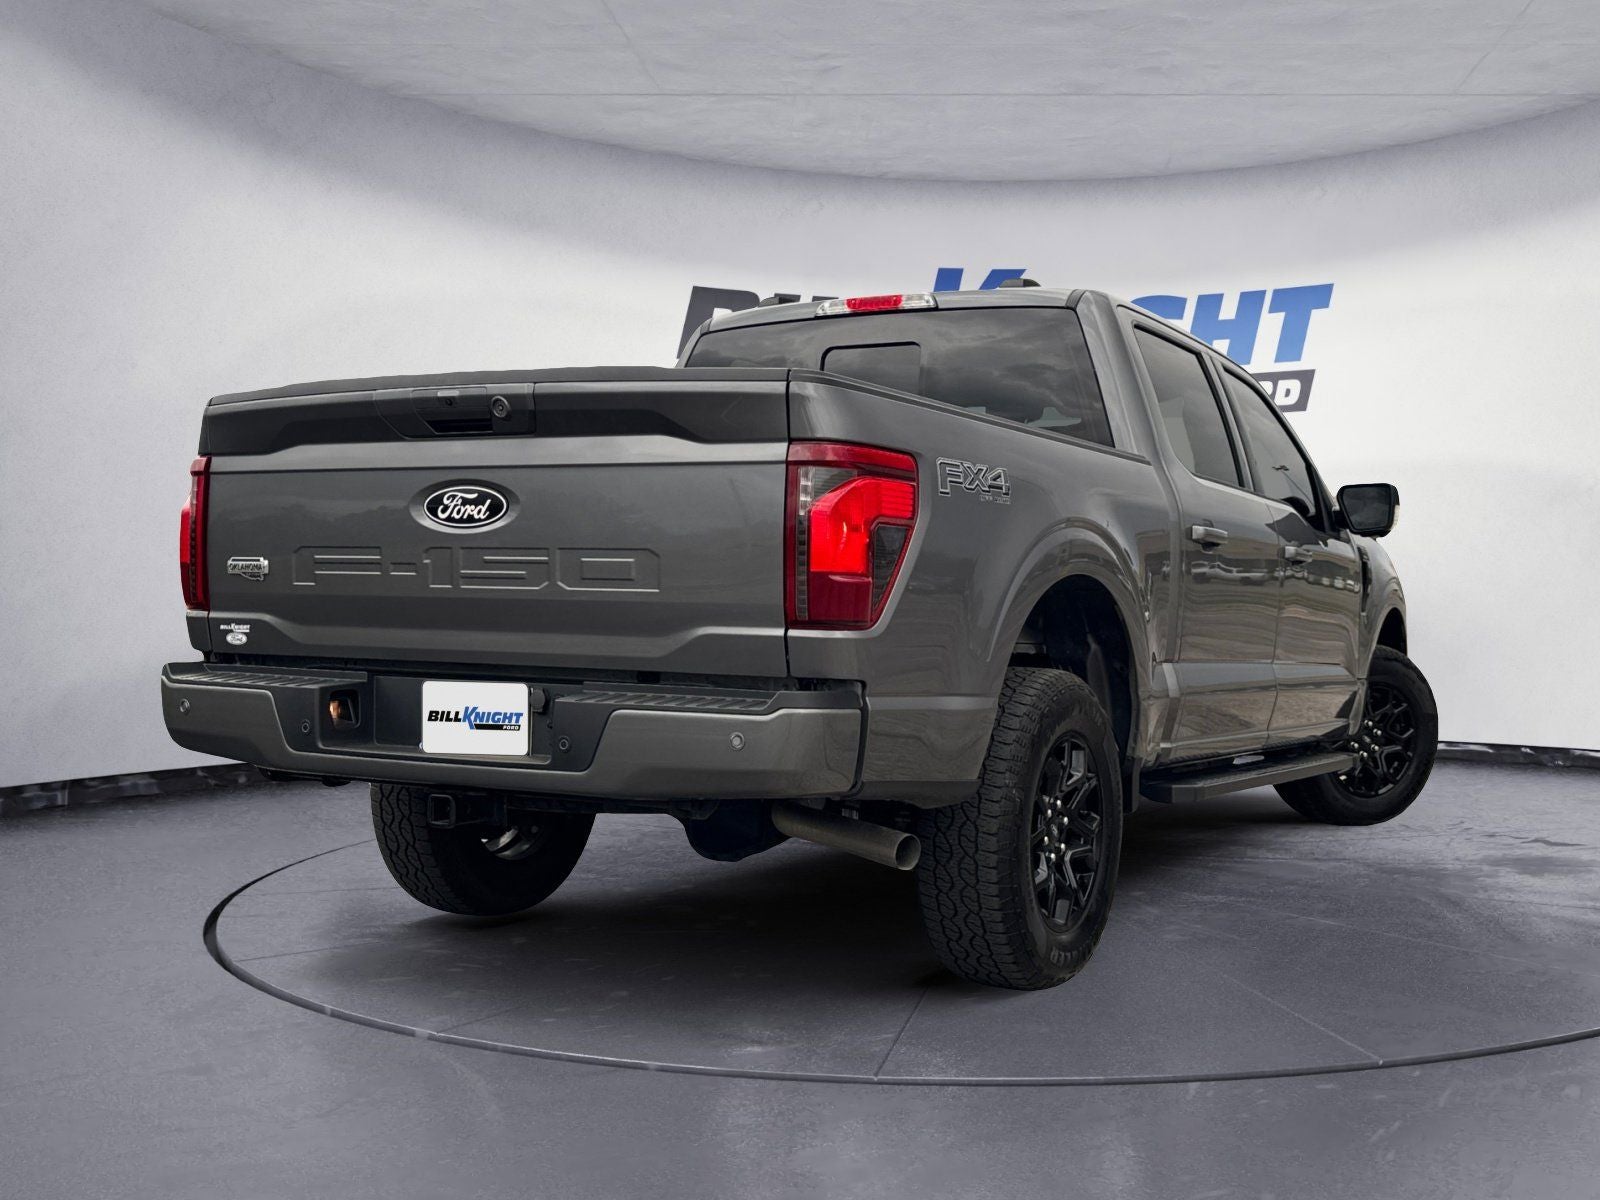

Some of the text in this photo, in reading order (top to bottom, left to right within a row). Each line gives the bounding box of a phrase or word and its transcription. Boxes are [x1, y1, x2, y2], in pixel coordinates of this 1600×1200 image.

[936, 457, 1011, 498] FX4
[437, 491, 491, 522] Ford
[228, 562, 263, 572] OKLAHOMA
[293, 546, 661, 592] F-150
